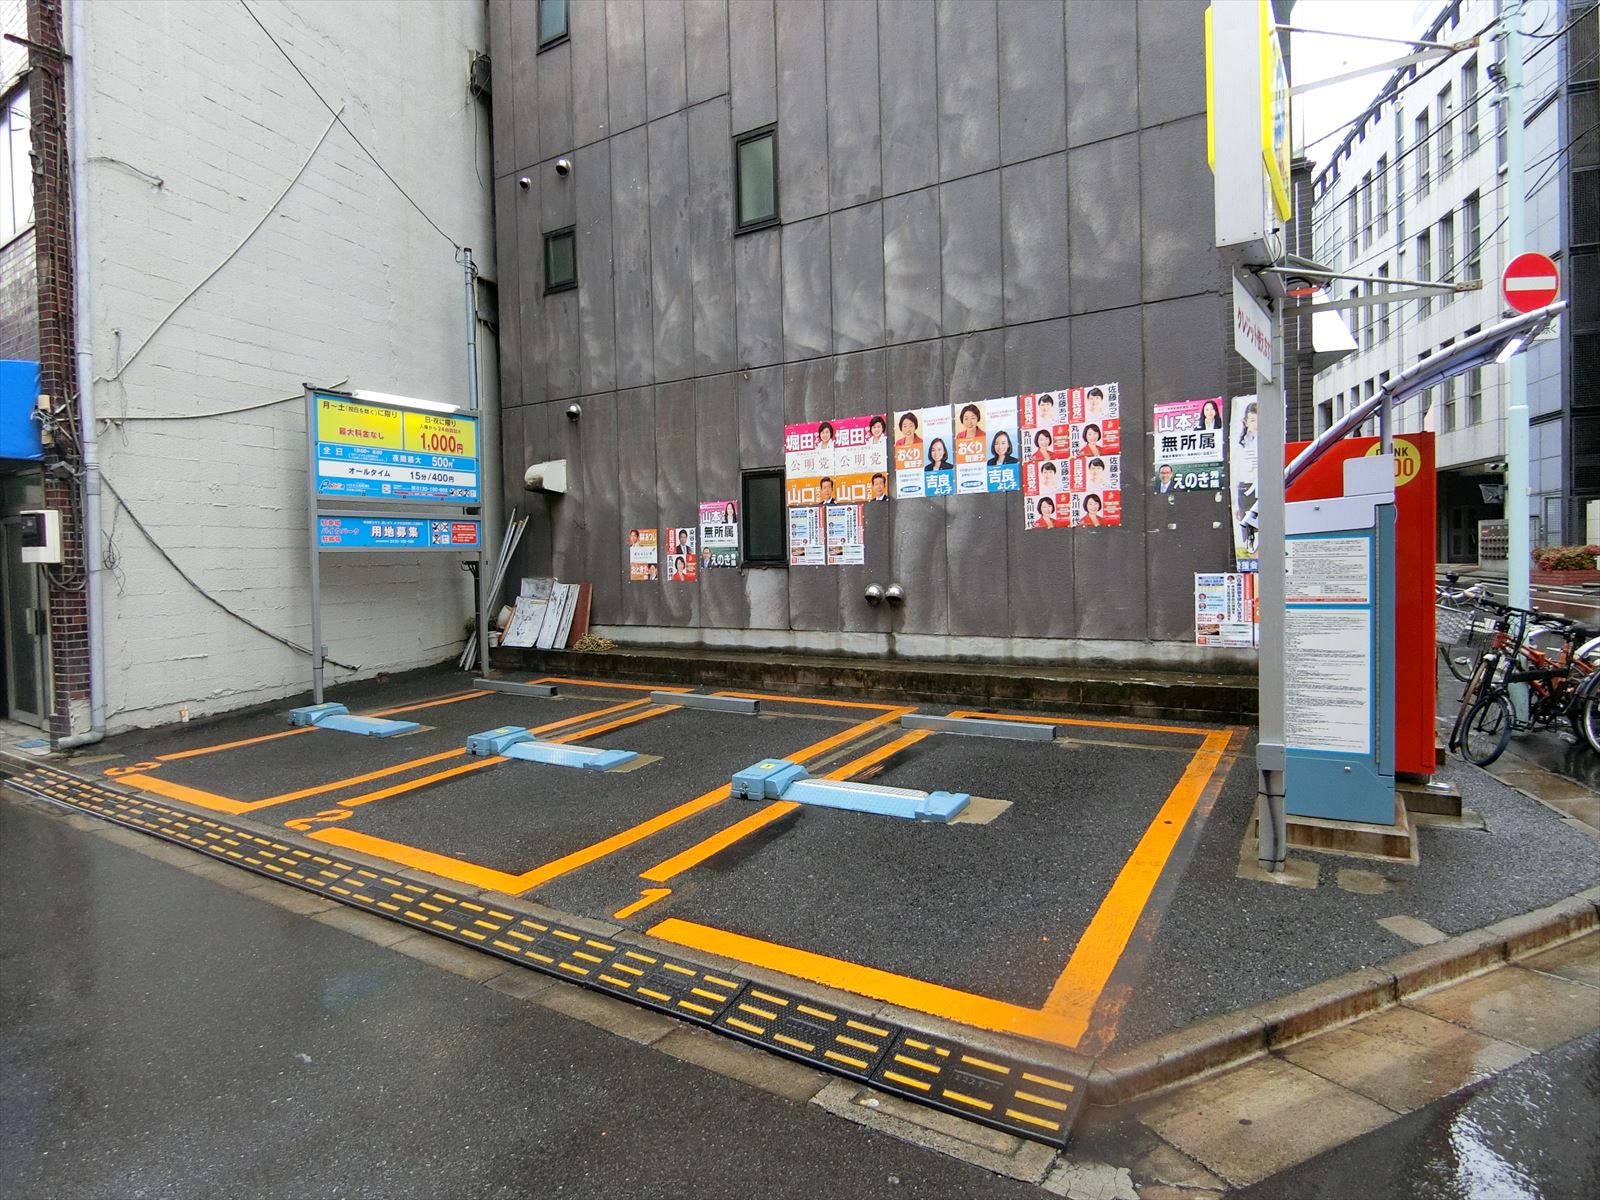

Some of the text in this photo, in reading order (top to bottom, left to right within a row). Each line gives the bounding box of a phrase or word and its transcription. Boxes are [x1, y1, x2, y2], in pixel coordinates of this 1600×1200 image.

[1108, 386, 1117, 418] 佐藤あつこ
[1158, 412, 1193, 433] 山本
[339, 427, 384, 440] 最大料金なし
[786, 433, 814, 451] 堀田
[836, 428, 865, 446] 堀田
[1072, 425, 1080, 456] 丸川珠代
[420, 432, 463, 454] 1,000円
[958, 441, 983, 455] おぐり
[1024, 431, 1032, 461] 丸川珠代
[1161, 433, 1215, 453] 無所属
[791, 456, 829, 471] 公明党
[840, 452, 881, 467] 公明党
[898, 448, 920, 461] おぐり
[349, 467, 454, 483] オールタイム 15分/400円
[926, 474, 950, 489] 吉良
[988, 468, 1014, 483] 吉良
[1061, 461, 1070, 492] 佐藤あつこ
[1110, 457, 1119, 489] 佐藤あつこ
[1173, 472, 1209, 490] えのき
[836, 484, 866, 501] 山口
[934, 486, 953, 495] よし子
[997, 481, 1018, 490] よし子
[787, 486, 814, 504] 山口
[702, 510, 722, 524] 山本
[1026, 497, 1035, 528] 丸川珠代
[1072, 494, 1080, 526] 丸川珠代
[371, 525, 419, 538] 用地募集
[704, 526, 734, 538] 無所属
[711, 554, 731, 566] えのき
[283, 809, 354, 831] 2
[613, 888, 673, 919] 1
